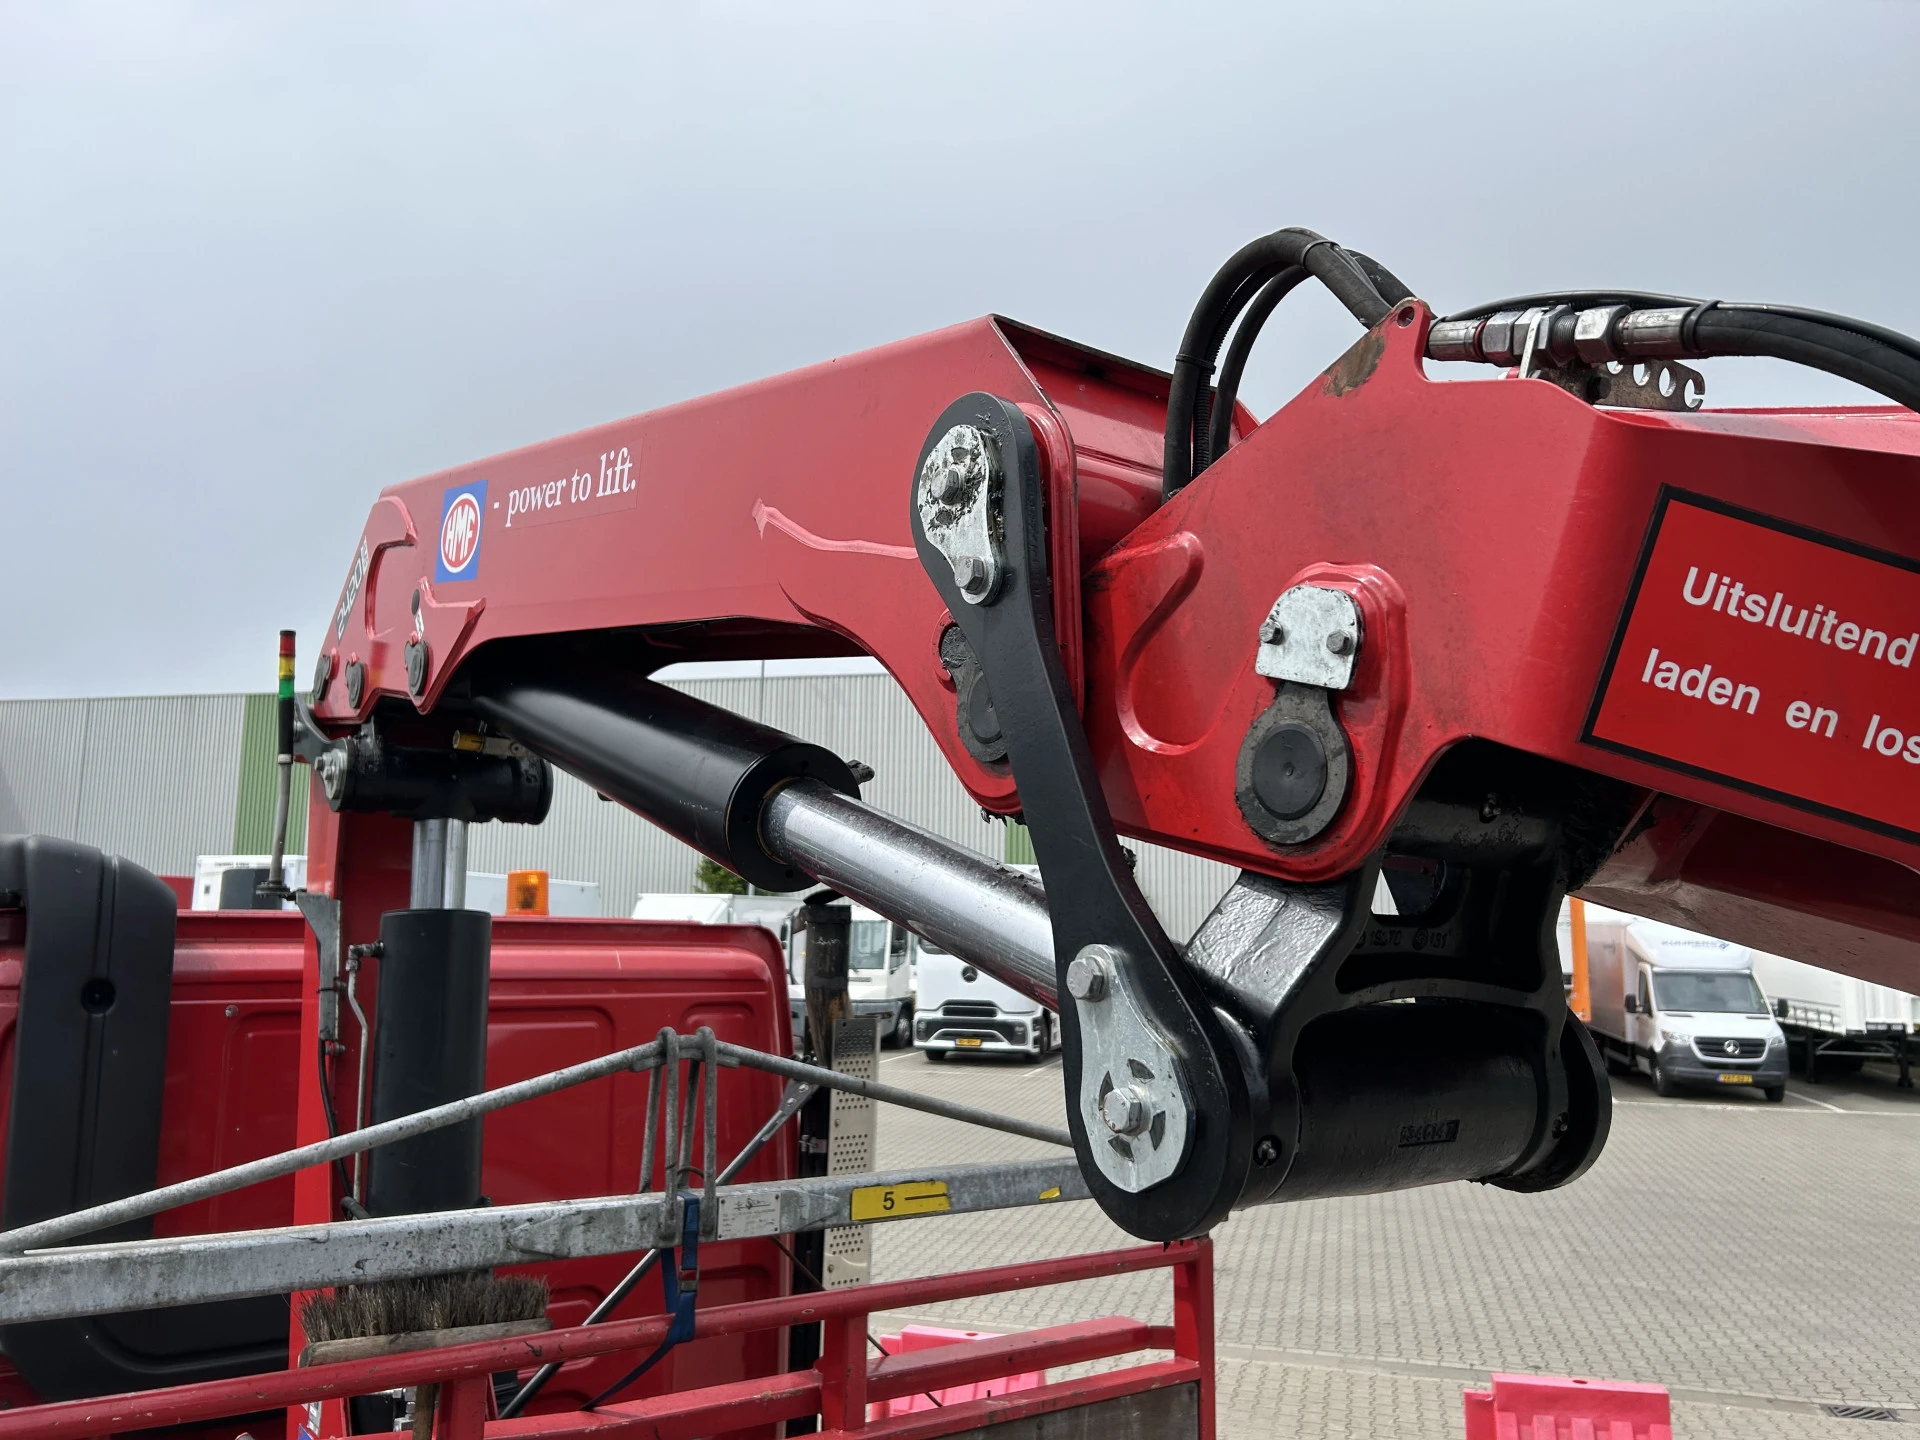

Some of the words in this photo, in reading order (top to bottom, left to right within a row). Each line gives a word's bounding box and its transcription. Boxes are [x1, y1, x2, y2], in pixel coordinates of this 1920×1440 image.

[505, 478, 567, 527] power
[571, 469, 592, 504] to
[596, 446, 636, 498] lift.
[445, 504, 476, 562] HMF
[336, 557, 363, 641] 2420
[1683, 567, 1920, 668] Uitsluitend
[1641, 648, 1761, 715] laden
[1785, 701, 1839, 738] en
[1862, 714, 1920, 764] los
[883, 1191, 895, 1211] 5
